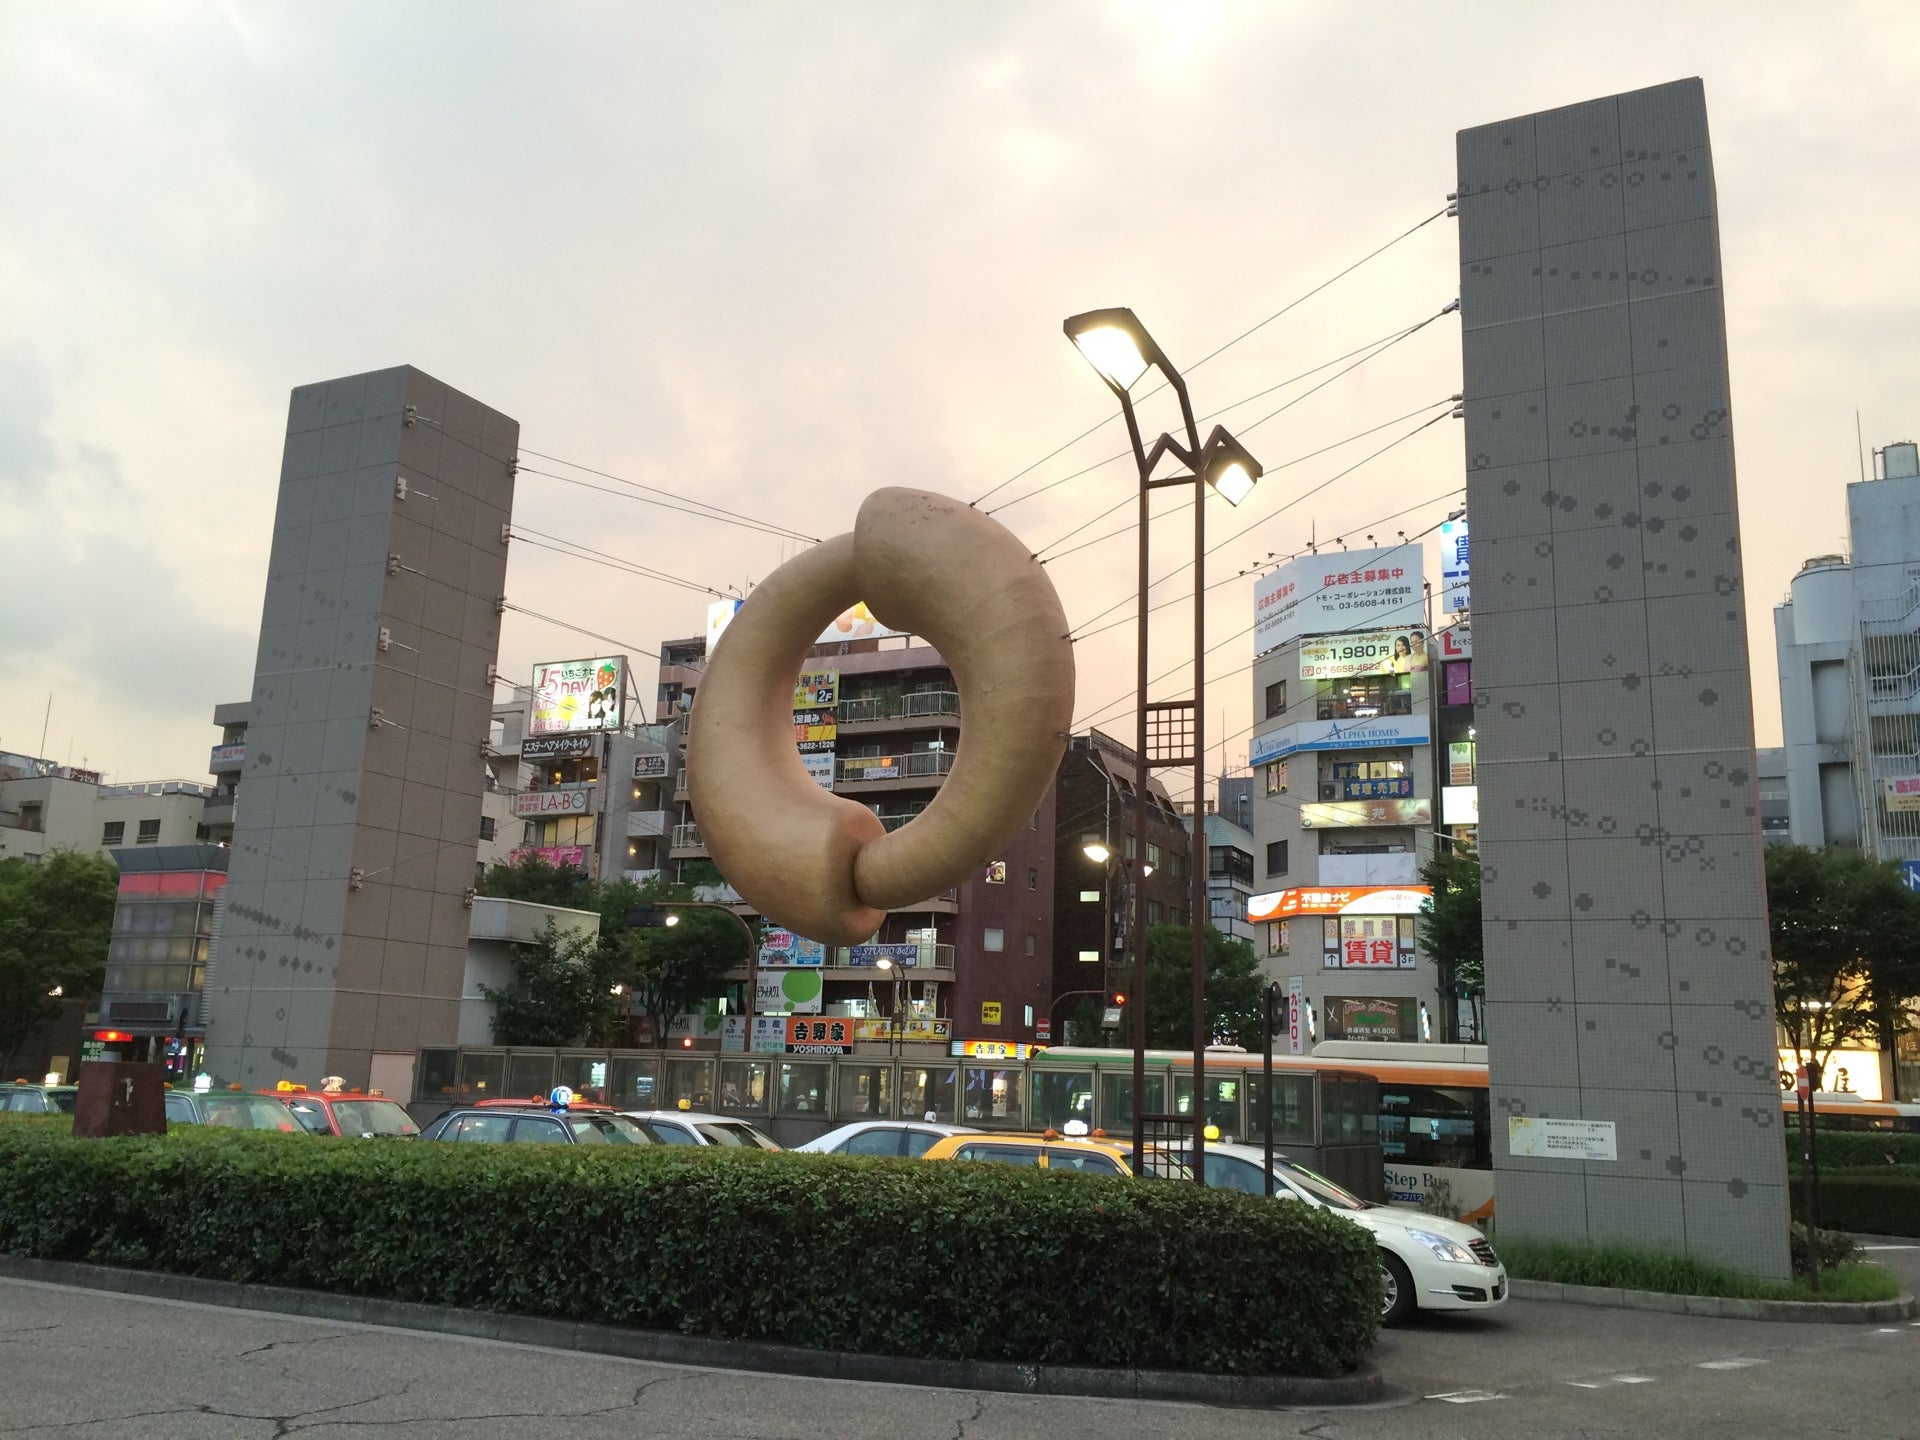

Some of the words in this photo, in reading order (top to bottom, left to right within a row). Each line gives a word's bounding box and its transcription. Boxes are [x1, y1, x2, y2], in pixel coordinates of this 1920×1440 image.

[1323, 567, 1404, 587] 広告主募集中
[1258, 582, 1295, 611] 広告主募集中
[1338, 597, 1404, 610] 03-5608-4161
[817, 689, 833, 703] 2F
[1368, 728, 1400, 739] HOMES
[862, 945, 895, 956] STUDIO
[1343, 939, 1394, 965] 賃貸
[1400, 953, 1414, 964] 3F
[793, 1021, 845, 1042] 吉野家
[1383, 1169, 1418, 1190] Step
